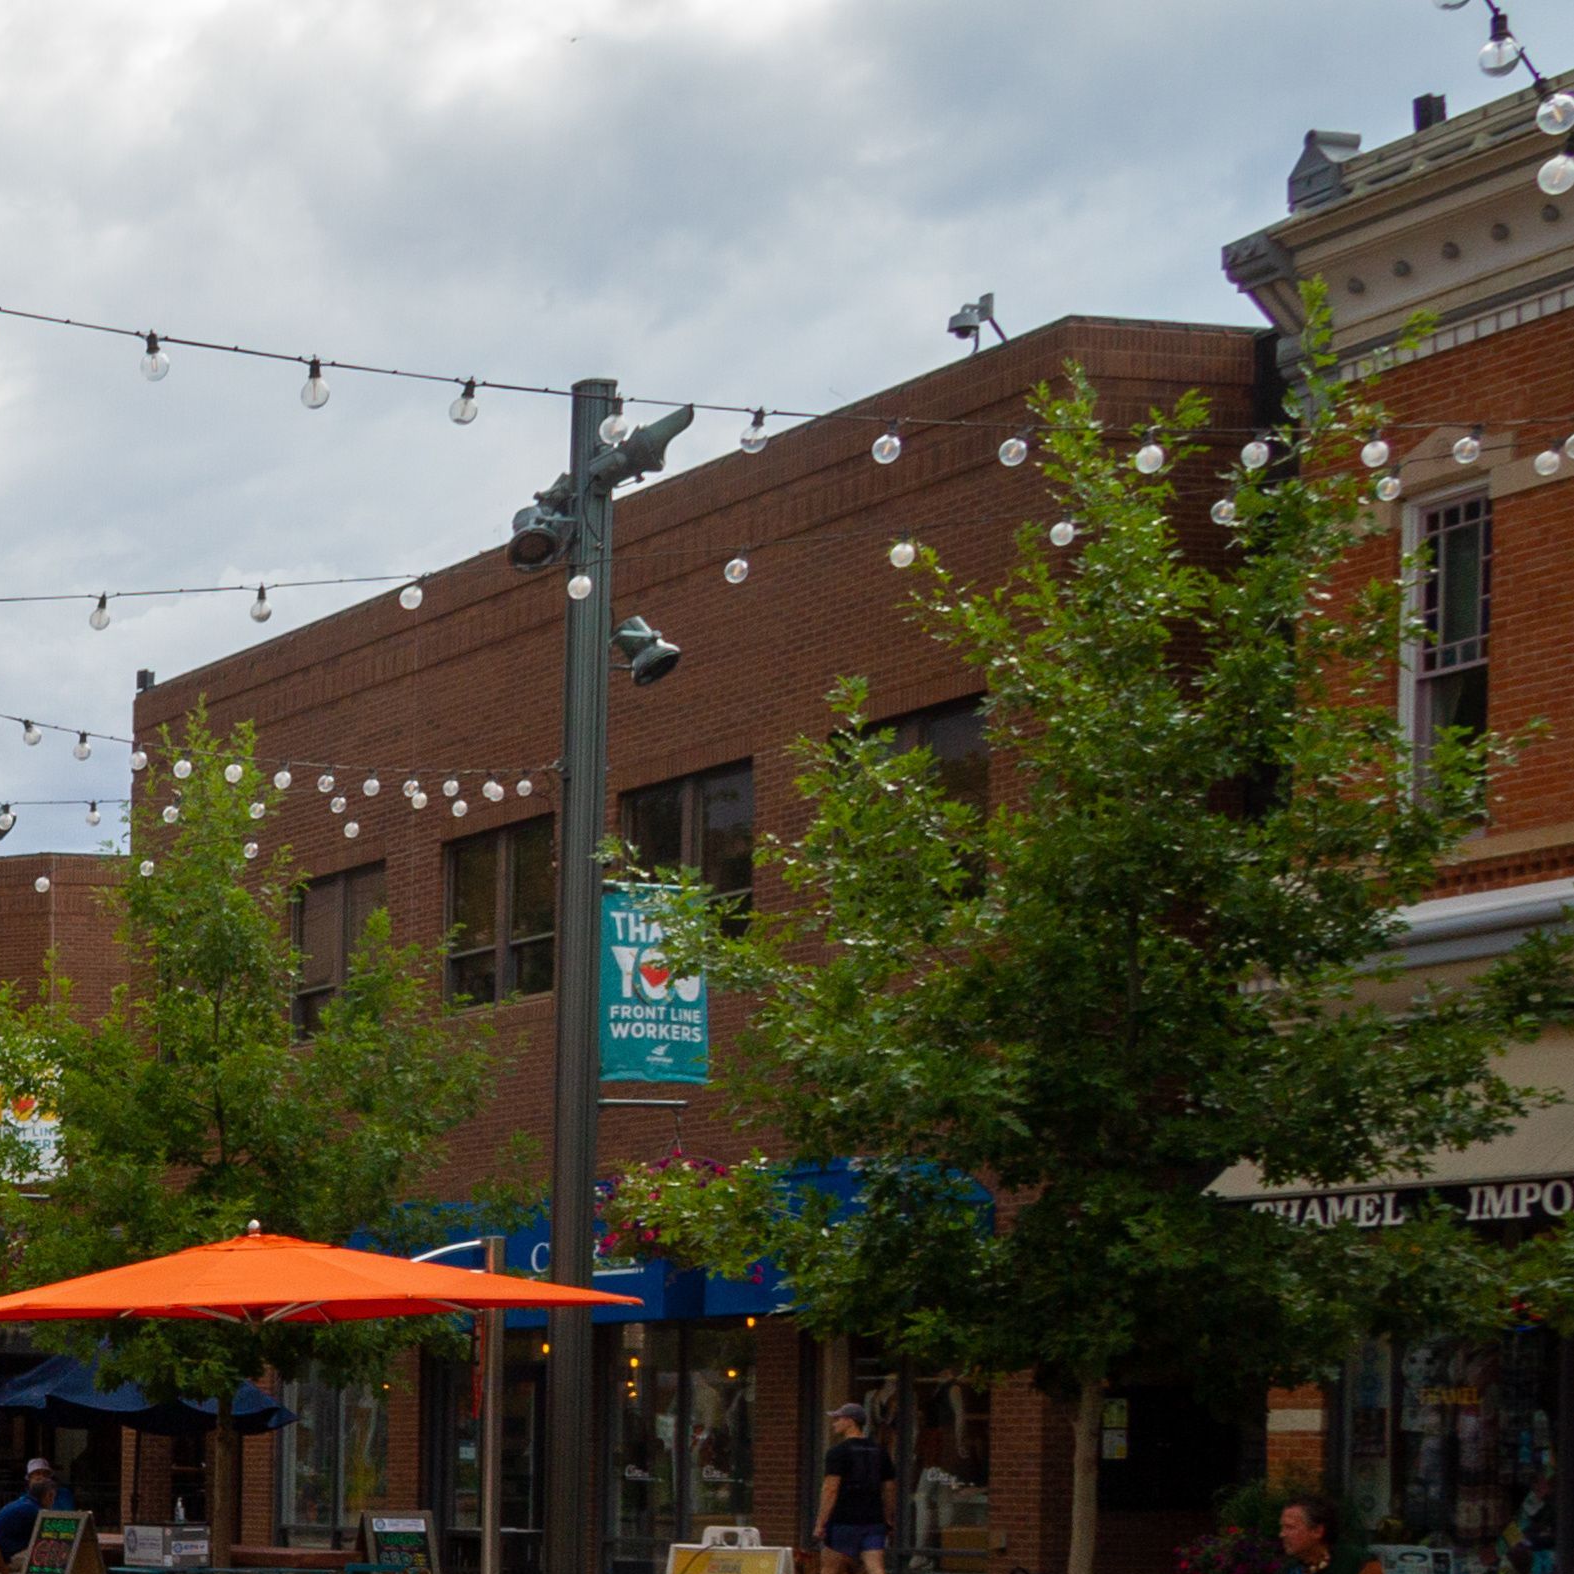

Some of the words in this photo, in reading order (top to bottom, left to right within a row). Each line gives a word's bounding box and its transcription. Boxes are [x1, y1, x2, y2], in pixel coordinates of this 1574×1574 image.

[609, 1004, 667, 1021] FRONT
[669, 1006, 702, 1024] LINE
[609, 1022, 703, 1043] WORKERS
[1466, 1179, 1574, 1220] IMPO
